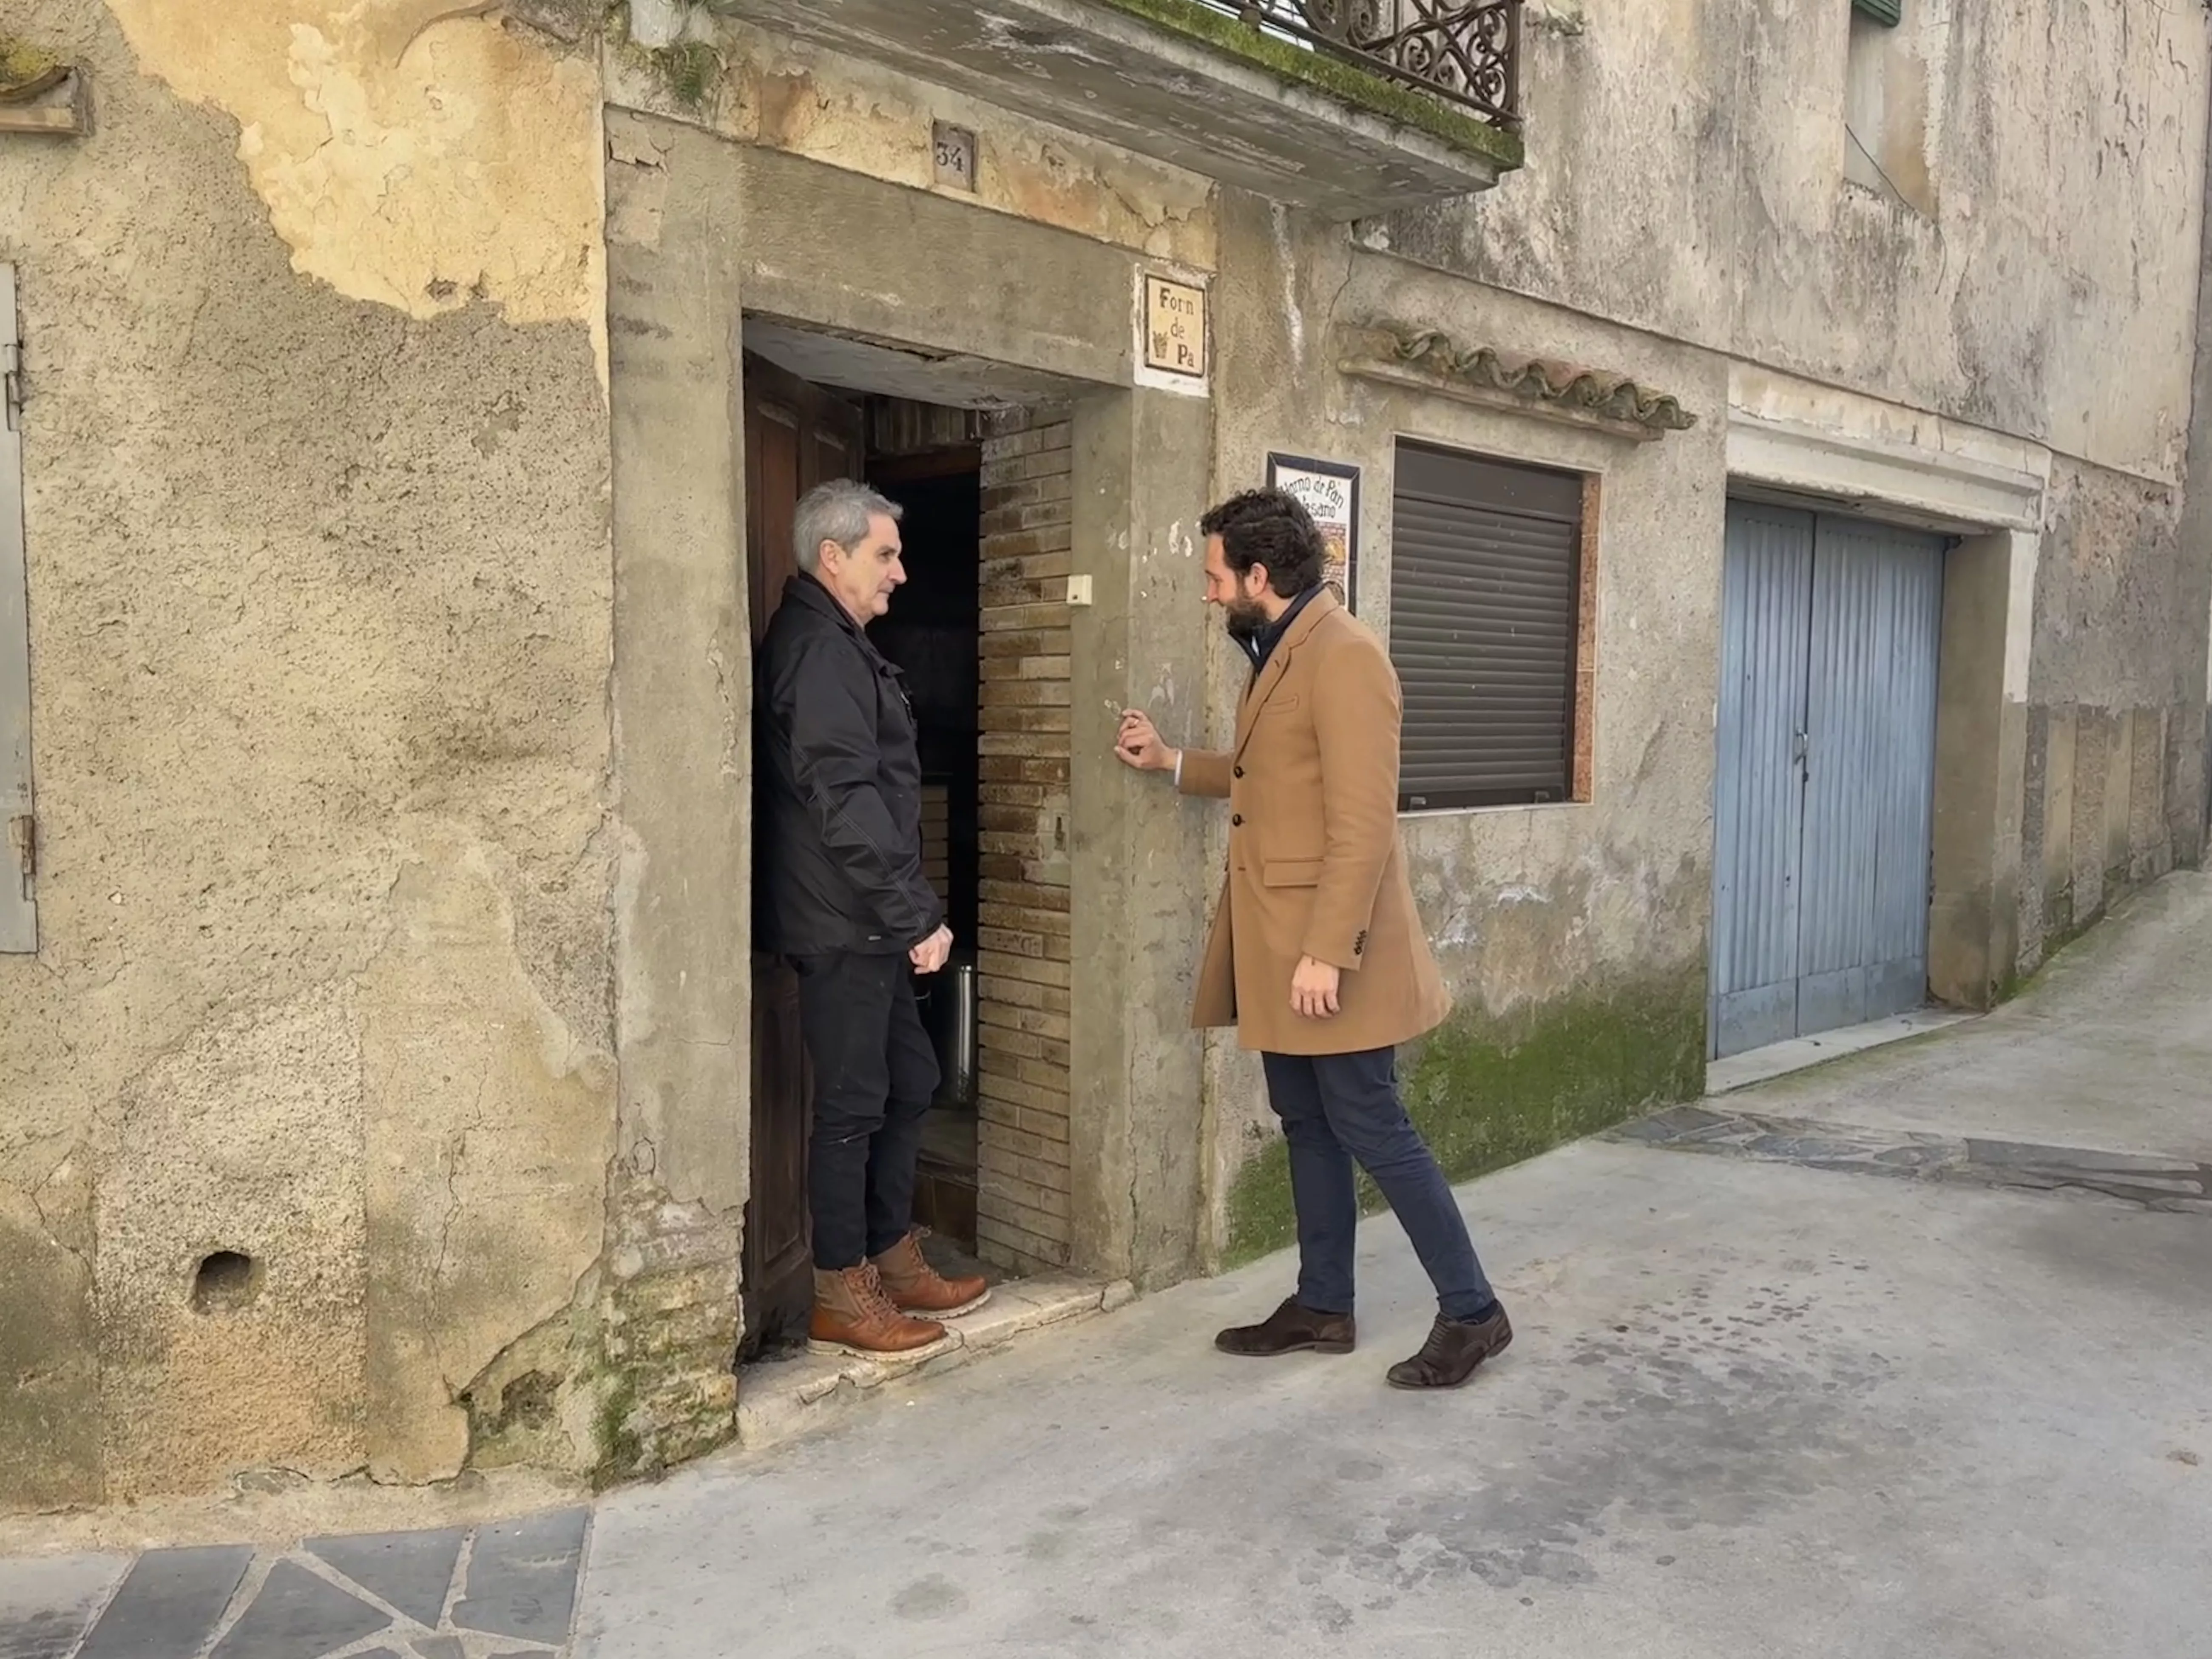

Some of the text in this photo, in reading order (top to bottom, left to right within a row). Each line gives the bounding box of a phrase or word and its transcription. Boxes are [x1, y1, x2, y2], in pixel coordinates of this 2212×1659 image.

[936, 141, 963, 172] 34
[1159, 287, 1194, 315] Forn
[1170, 317, 1185, 339] de
[1177, 344, 1194, 367] Pa
[1325, 479, 1344, 509] Pan
